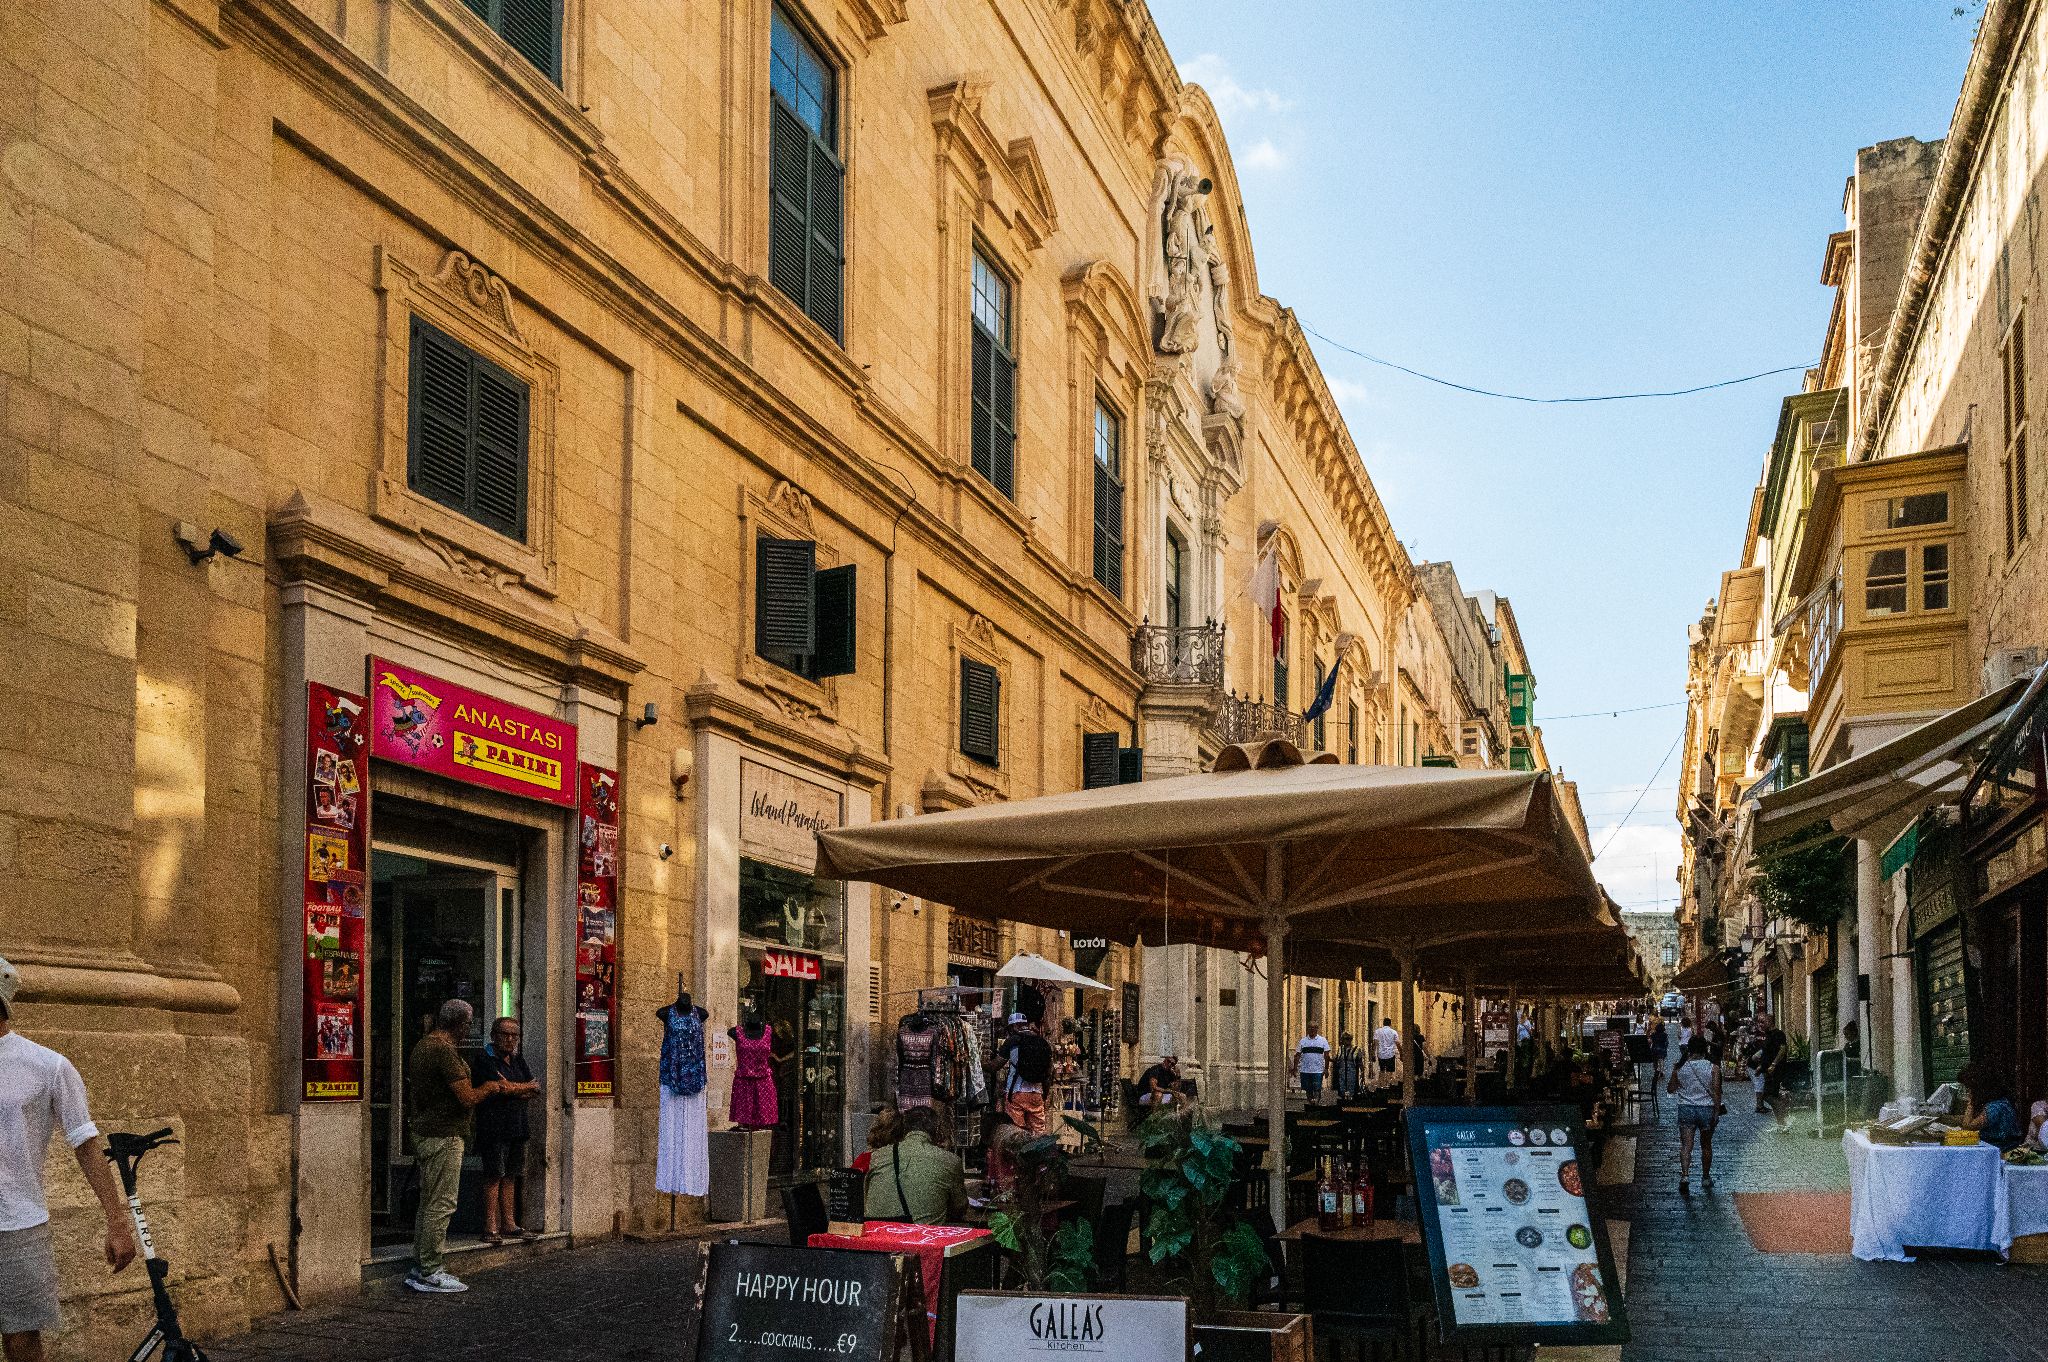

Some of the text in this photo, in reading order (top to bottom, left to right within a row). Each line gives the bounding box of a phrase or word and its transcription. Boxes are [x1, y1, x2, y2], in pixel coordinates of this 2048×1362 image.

[453, 704, 563, 752] ANASTASI
[486, 744, 559, 778] PANINI
[751, 790, 830, 832] Island Paradise
[307, 904, 342, 913] FOOTBALL
[764, 952, 817, 980] SALE
[715, 1053, 727, 1061] OFF
[321, 1083, 357, 1091] PANINI
[135, 1208, 153, 1248] BIRD
[736, 1272, 862, 1307] HAPPY HOUR
[1029, 1302, 1104, 1340] GALEA'S
[837, 1333, 857, 1354] €9
